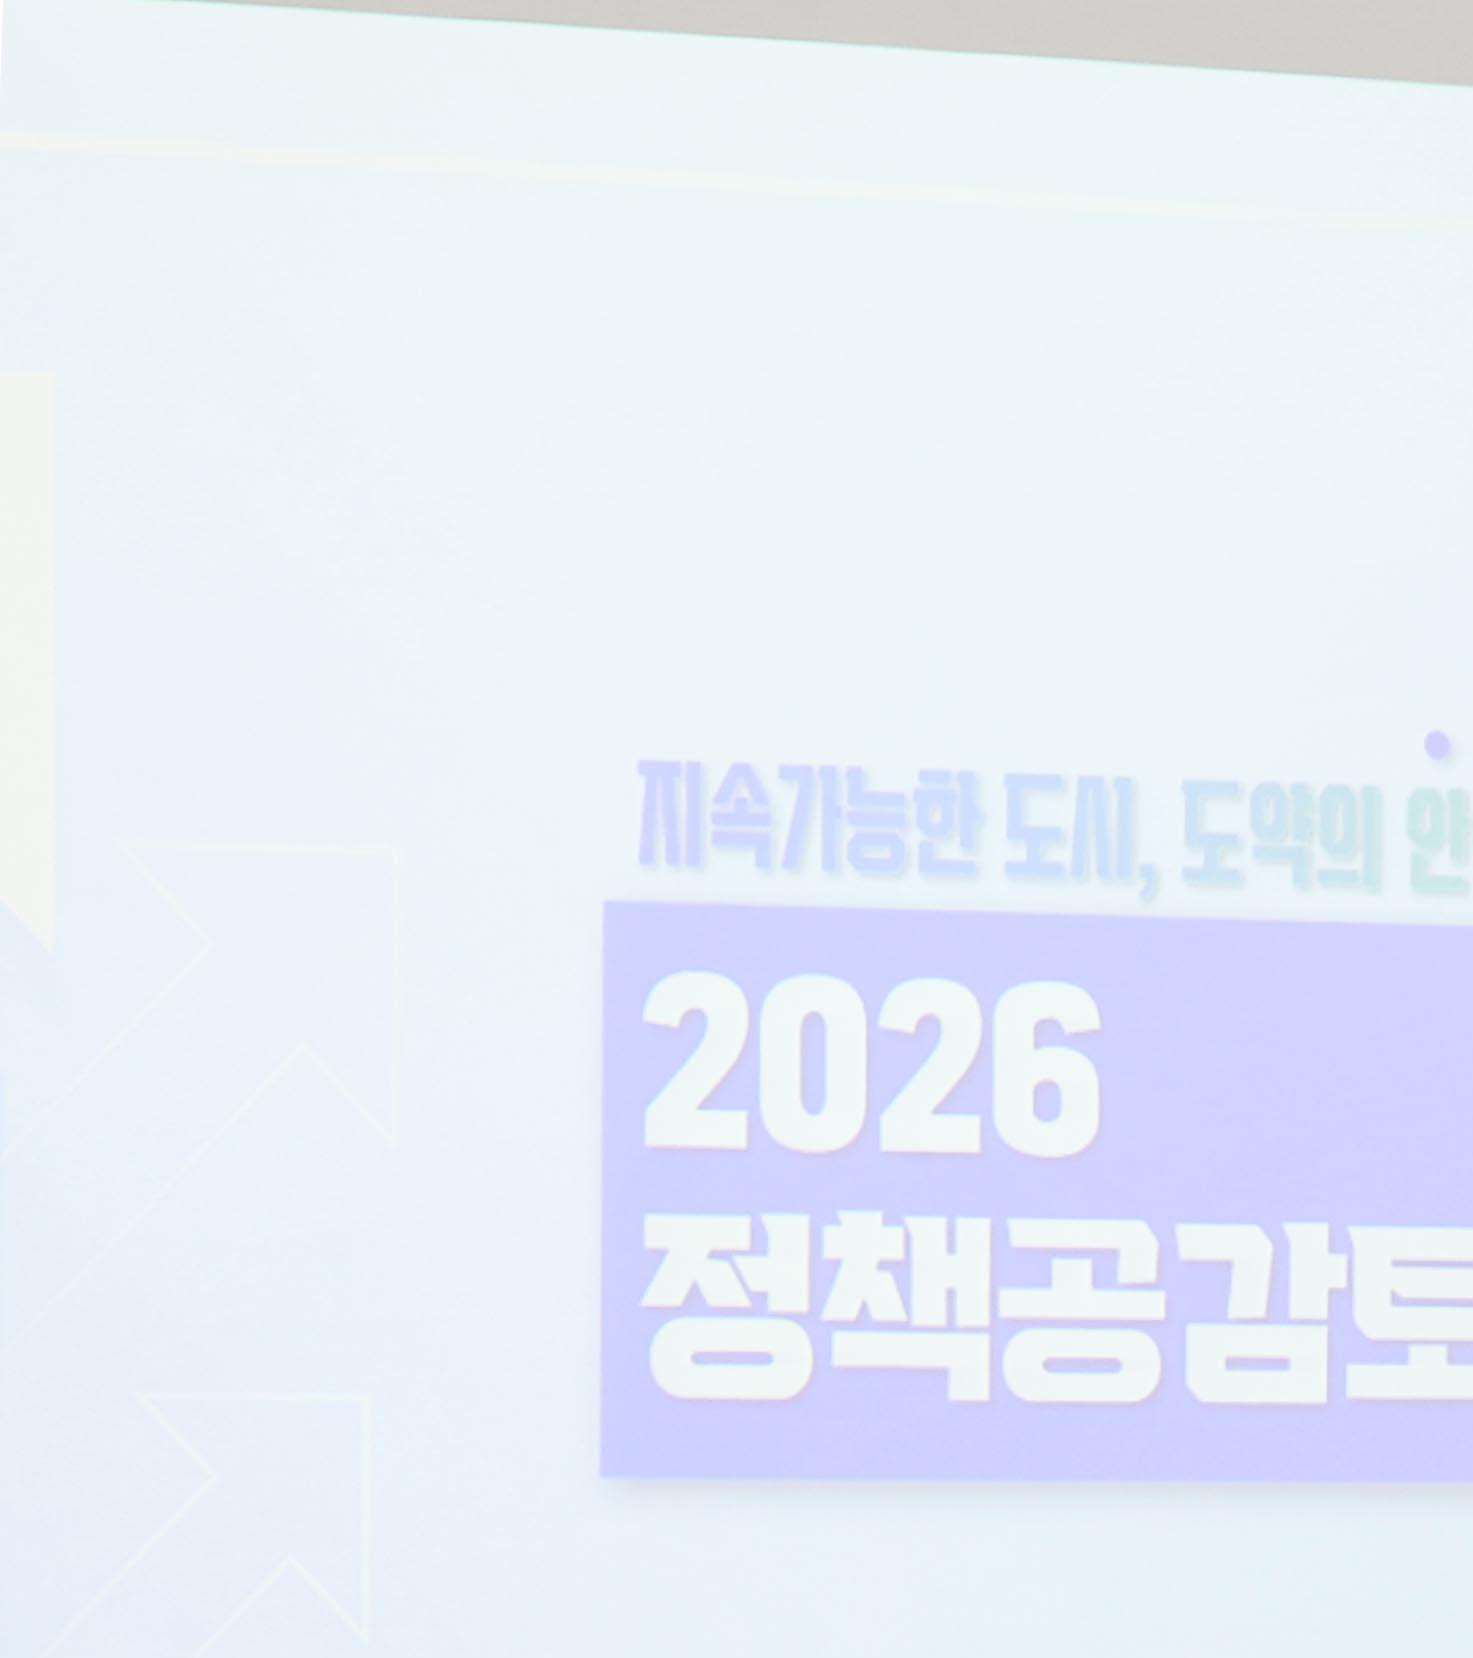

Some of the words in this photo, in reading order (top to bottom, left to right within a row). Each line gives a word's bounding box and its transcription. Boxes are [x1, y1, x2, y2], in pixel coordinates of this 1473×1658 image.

[636, 758, 984, 879] 지속가능한
[1003, 771, 1159, 901] 도시,
[1180, 778, 1383, 895] 도약의
[642, 969, 1102, 1158] 2026
